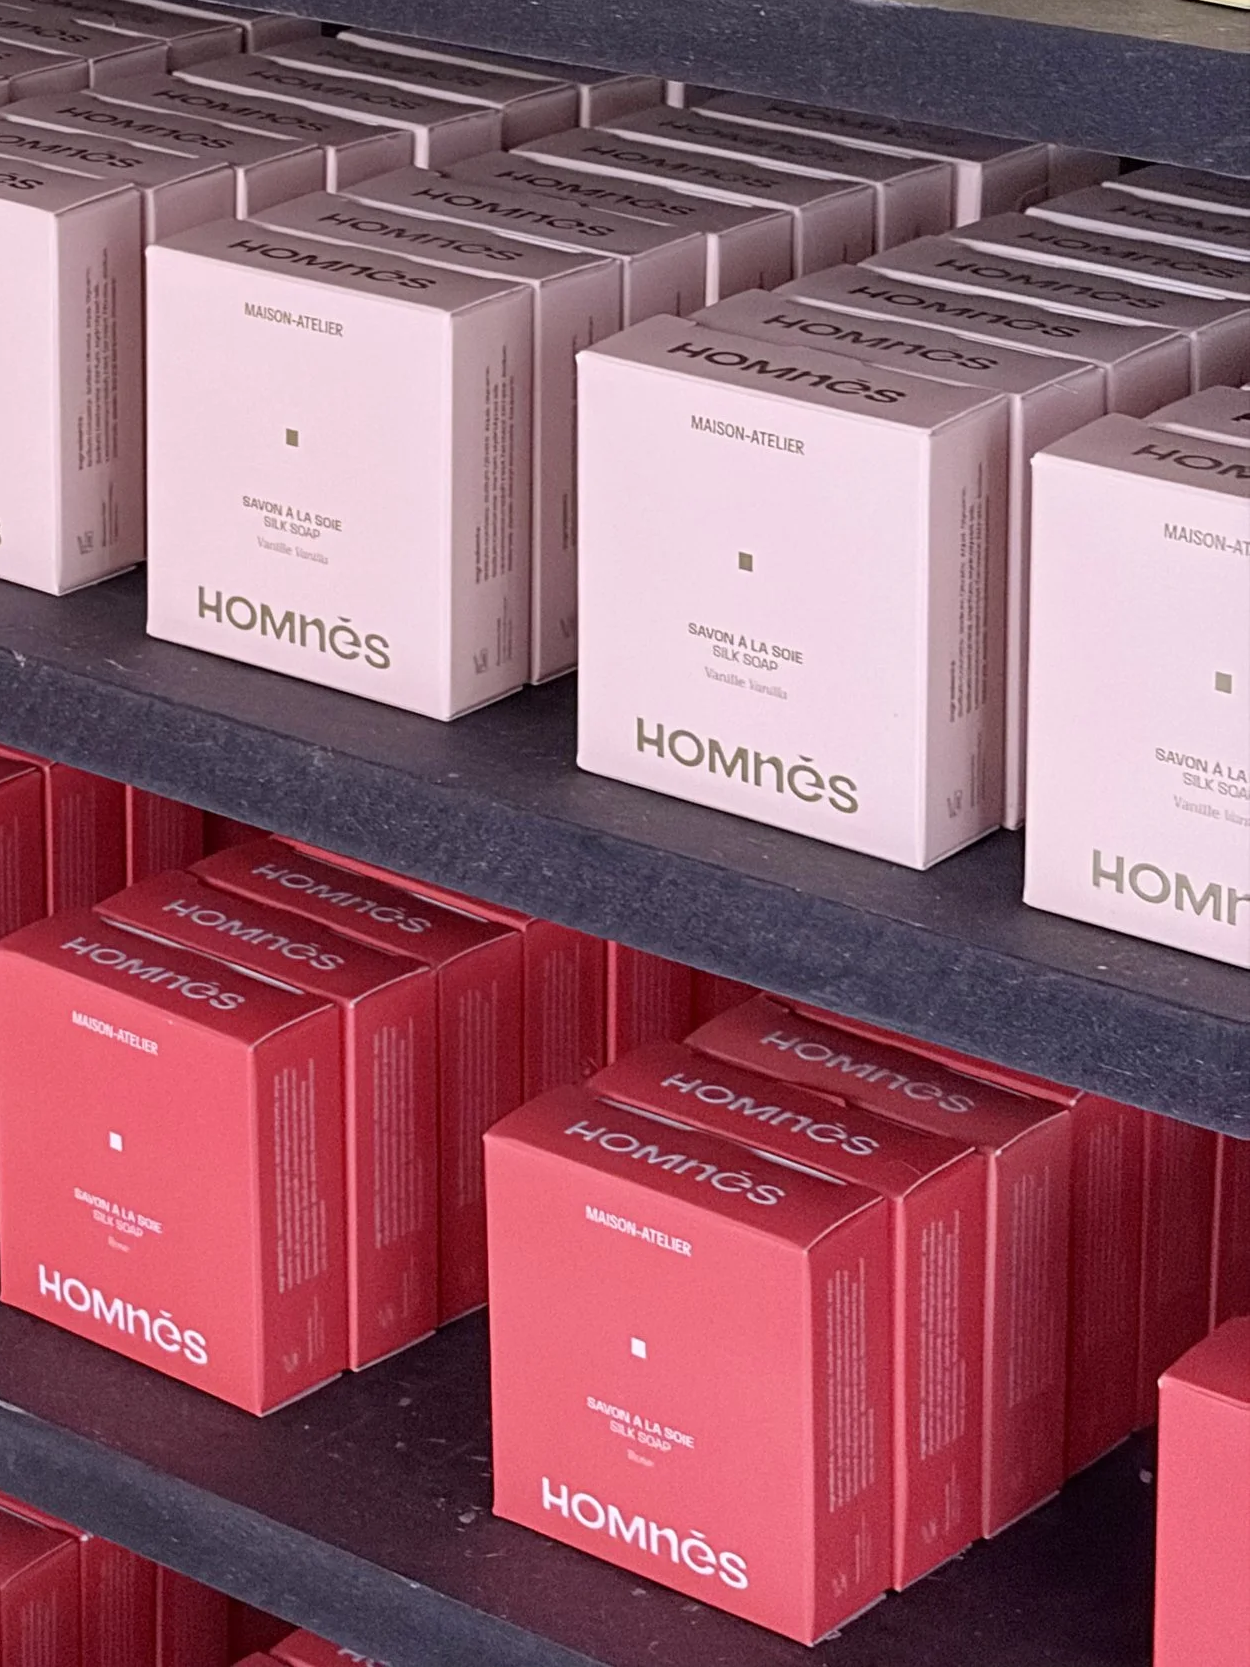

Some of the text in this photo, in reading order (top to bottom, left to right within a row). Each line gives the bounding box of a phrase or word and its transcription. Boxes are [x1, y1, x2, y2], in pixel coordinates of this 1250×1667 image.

[244, 302, 343, 337] MAISON-ATELIER
[691, 415, 804, 455] MAISON-ATELIER
[242, 495, 282, 516] SAVON
[296, 509, 311, 523] LA
[314, 514, 342, 532] SOIE
[263, 515, 320, 539] SILK SOAP
[688, 622, 734, 645] SAVON
[750, 639, 768, 654] LA
[771, 645, 803, 664] SOIE
[712, 644, 778, 671] SILK SOAP
[1155, 747, 1208, 774] SAVON
[1227, 766, 1248, 783] LA
[1183, 772, 1214, 792] SILK
[585, 1205, 691, 1256] MAISON-ATELIER
[587, 1396, 630, 1423] SAVON
[644, 1419, 661, 1435] LA
[664, 1427, 693, 1448] SOIE
